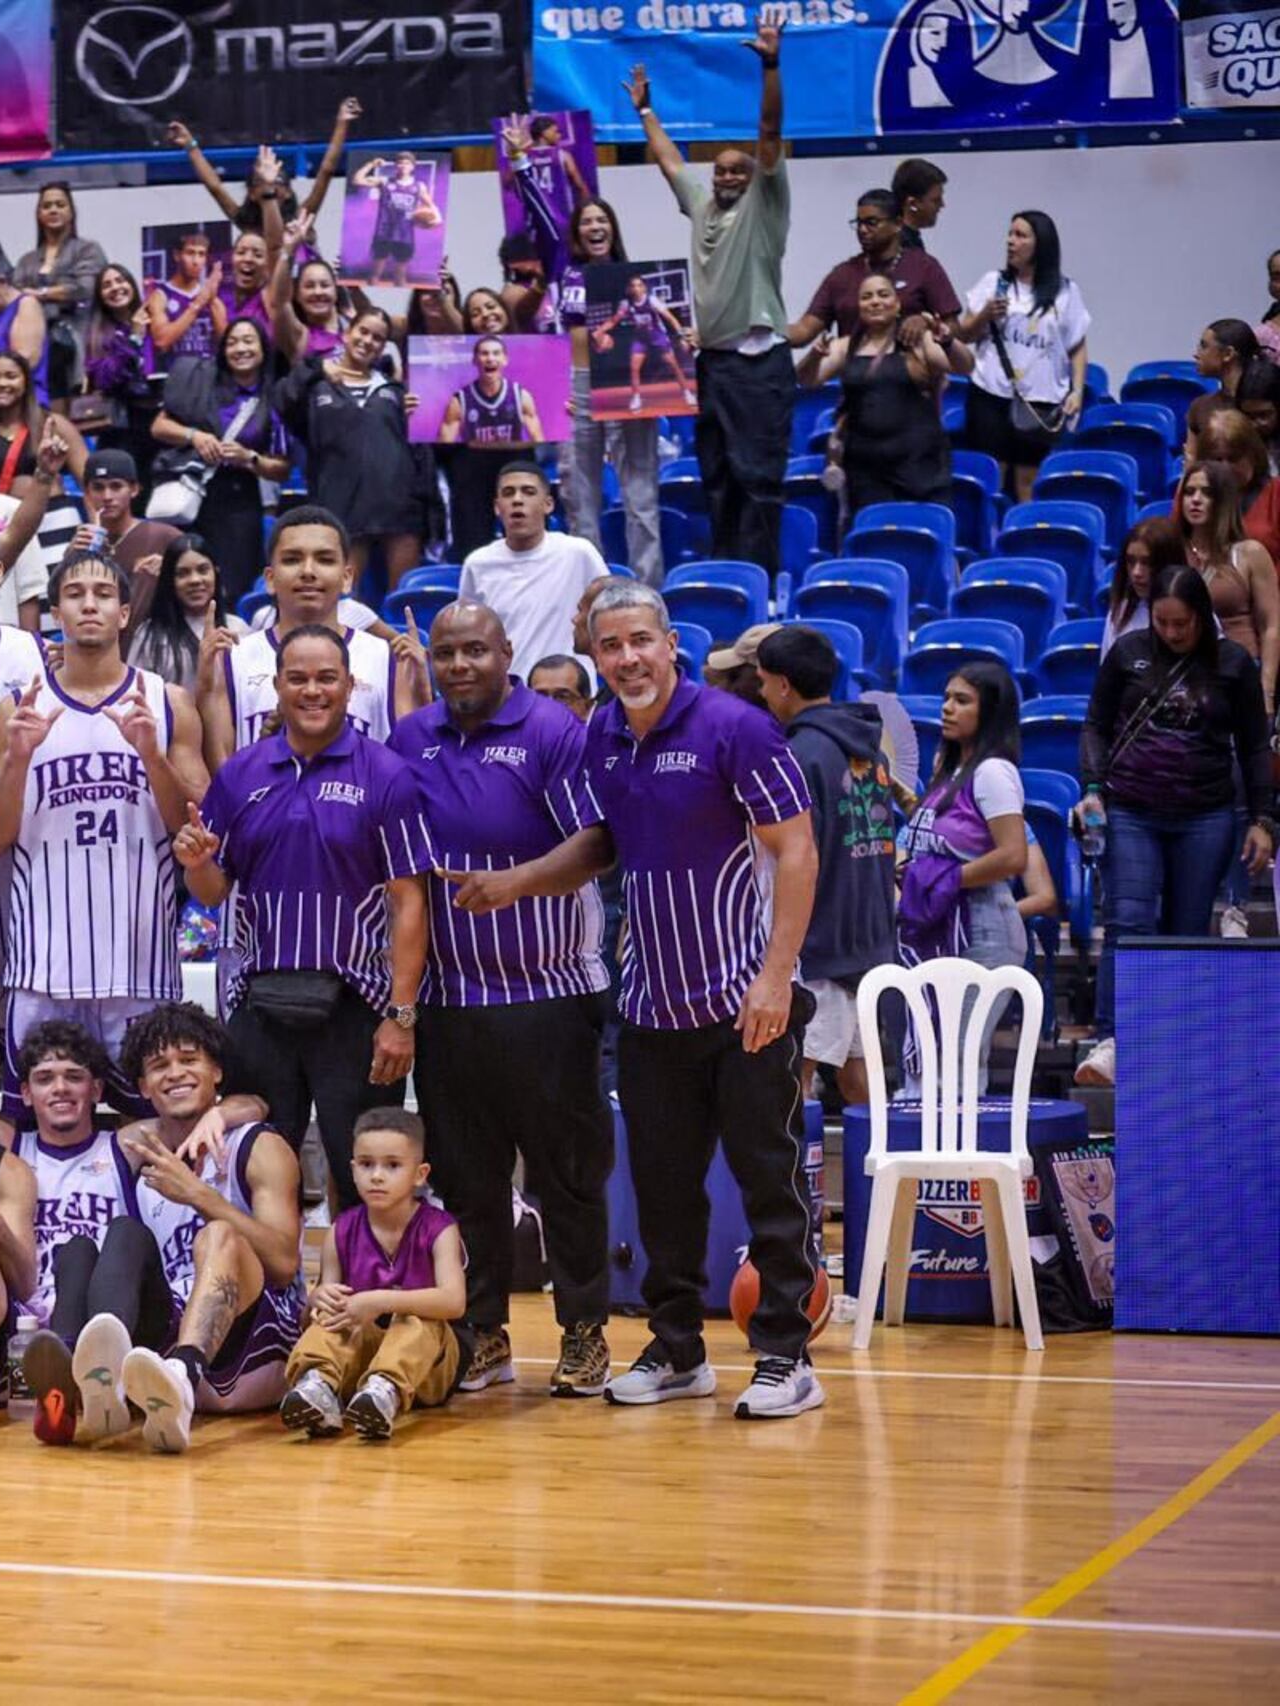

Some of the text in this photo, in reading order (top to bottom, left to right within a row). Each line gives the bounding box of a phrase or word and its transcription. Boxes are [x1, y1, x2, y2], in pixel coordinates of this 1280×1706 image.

[541, 4, 624, 39] que
[637, 0, 747, 31] dura
[34, 751, 151, 815] JIREH
[49, 785, 140, 809] KINGDOM
[316, 781, 365, 803] JIREH
[75, 809, 118, 846] 24
[33, 1191, 118, 1228] REH
[907, 1249, 978, 1271] Future
